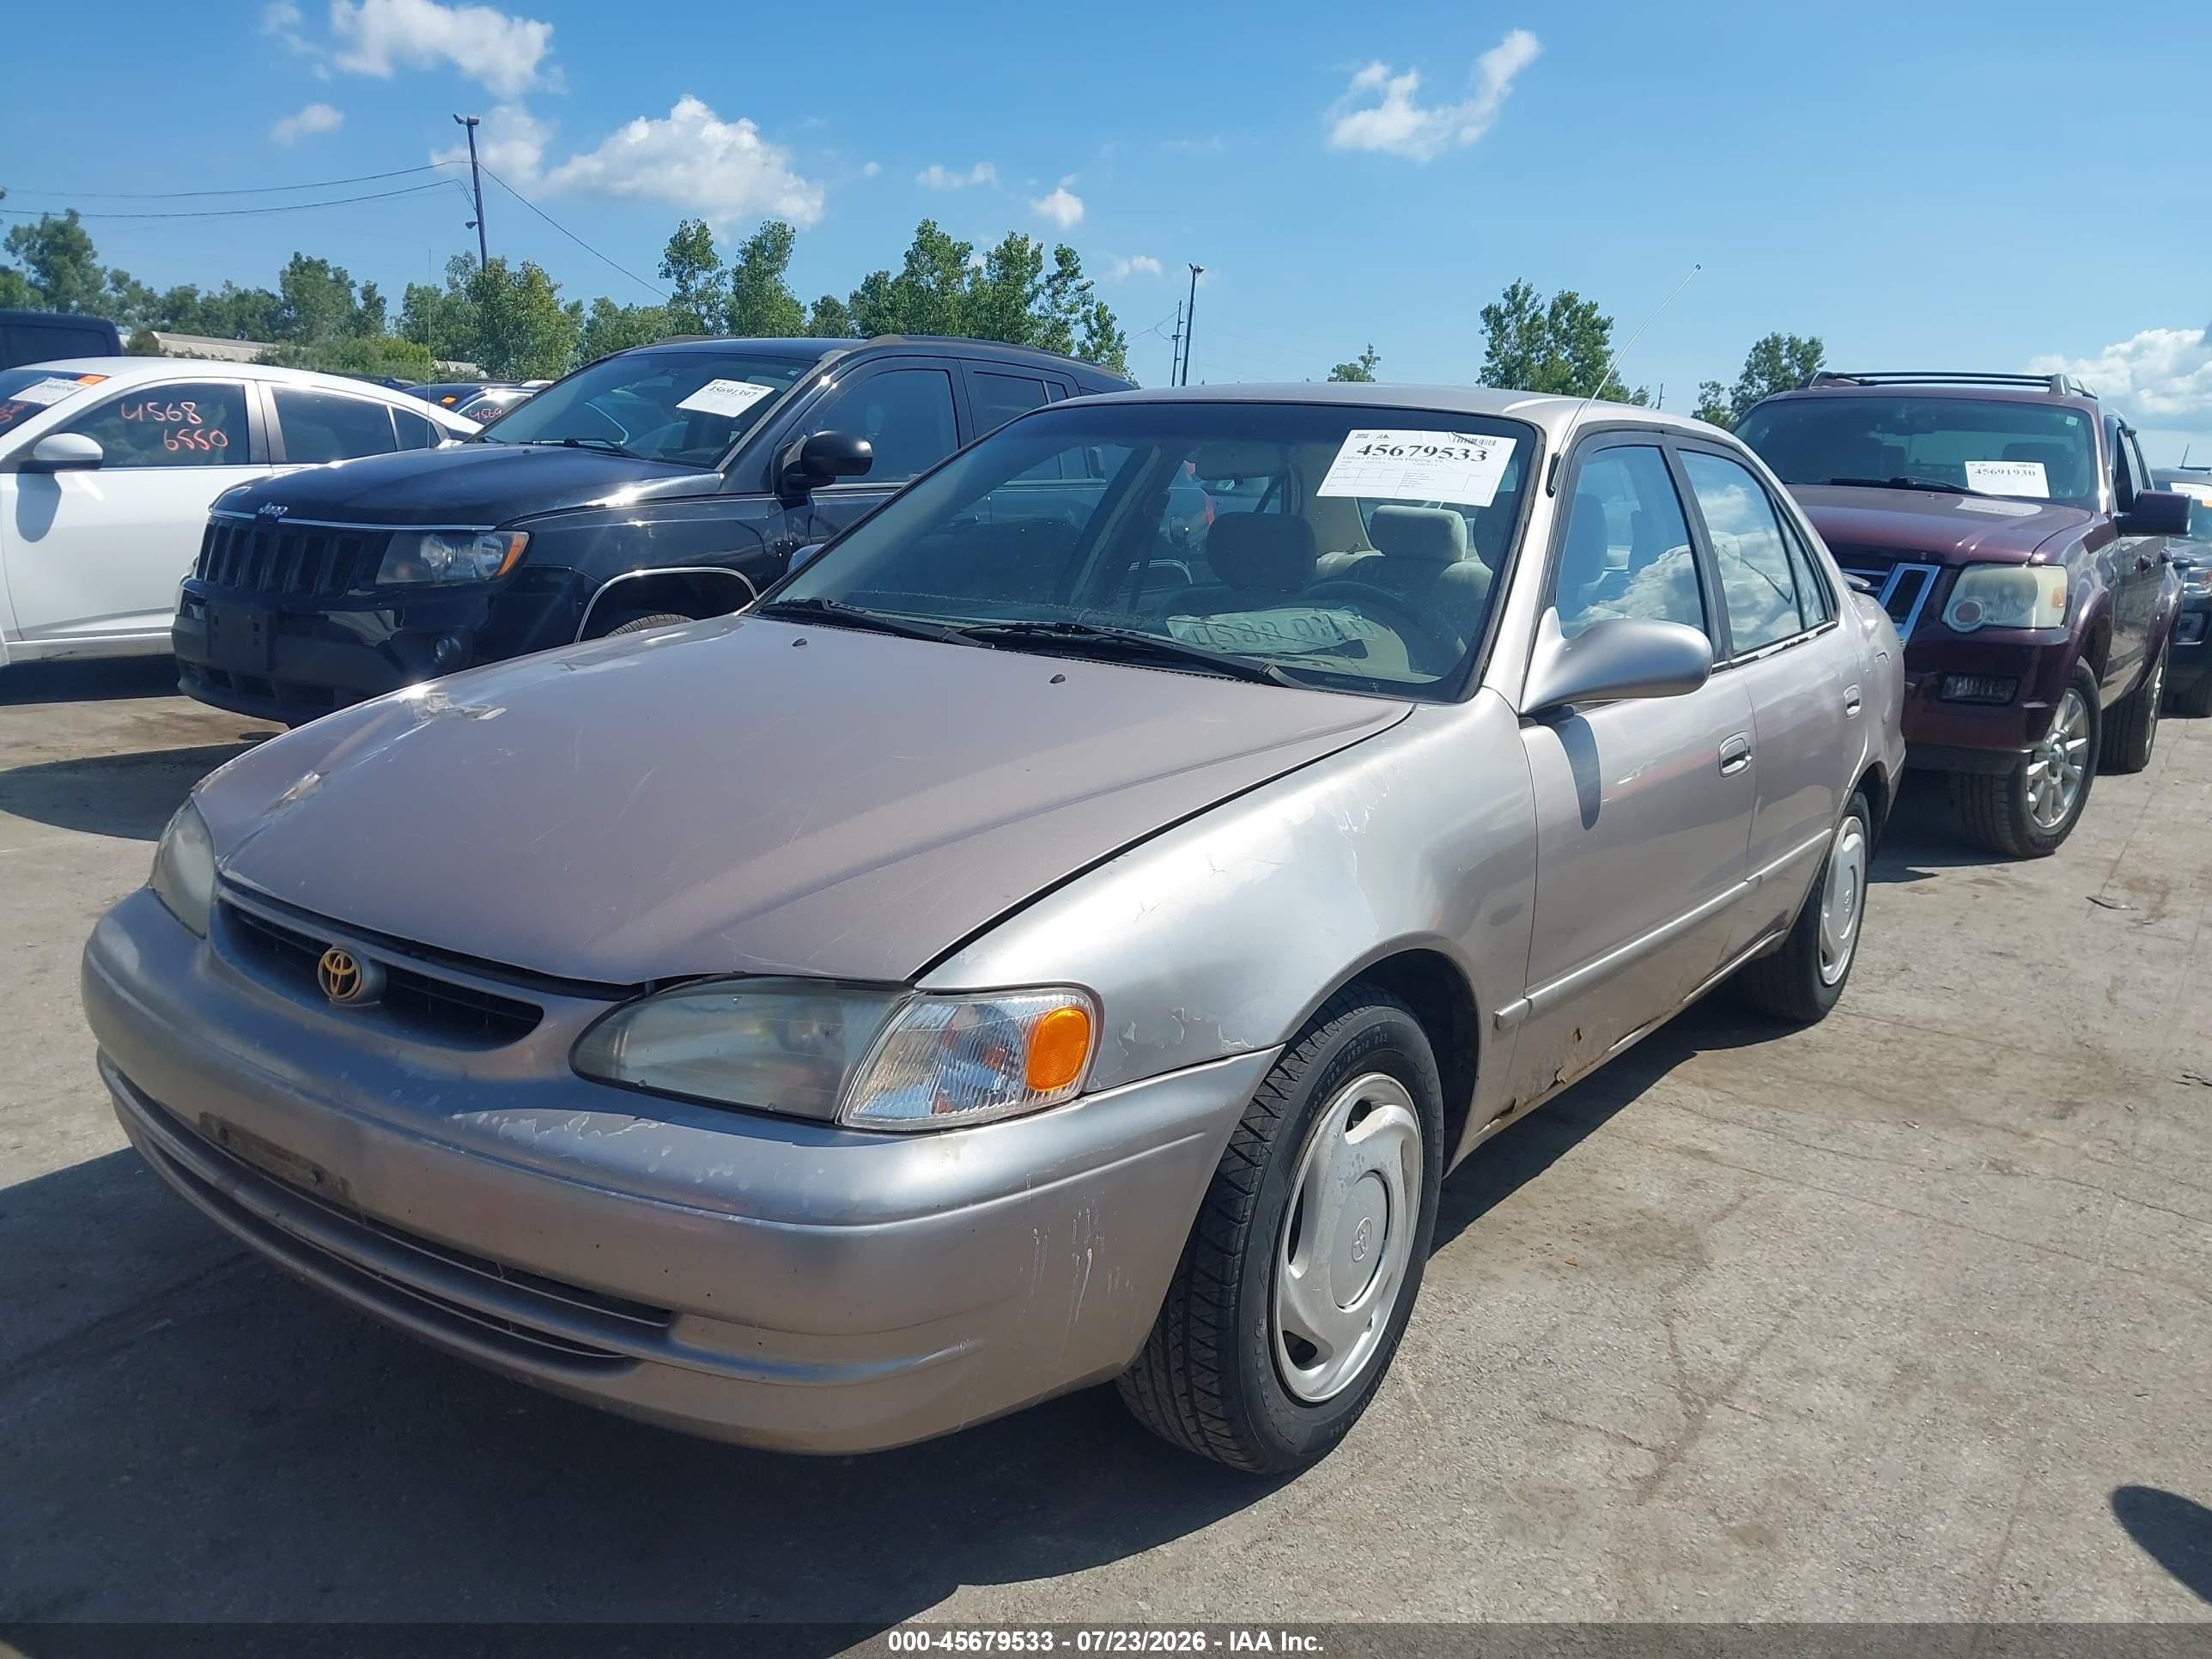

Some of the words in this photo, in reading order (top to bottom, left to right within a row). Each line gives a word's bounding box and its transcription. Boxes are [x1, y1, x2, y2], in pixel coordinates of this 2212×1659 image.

[708, 386, 757, 398] 45691397
[121, 401, 203, 424] 4568
[163, 428, 228, 451] 6550
[1356, 443, 1488, 462] 45679533
[1974, 468, 2036, 477] 45691930
